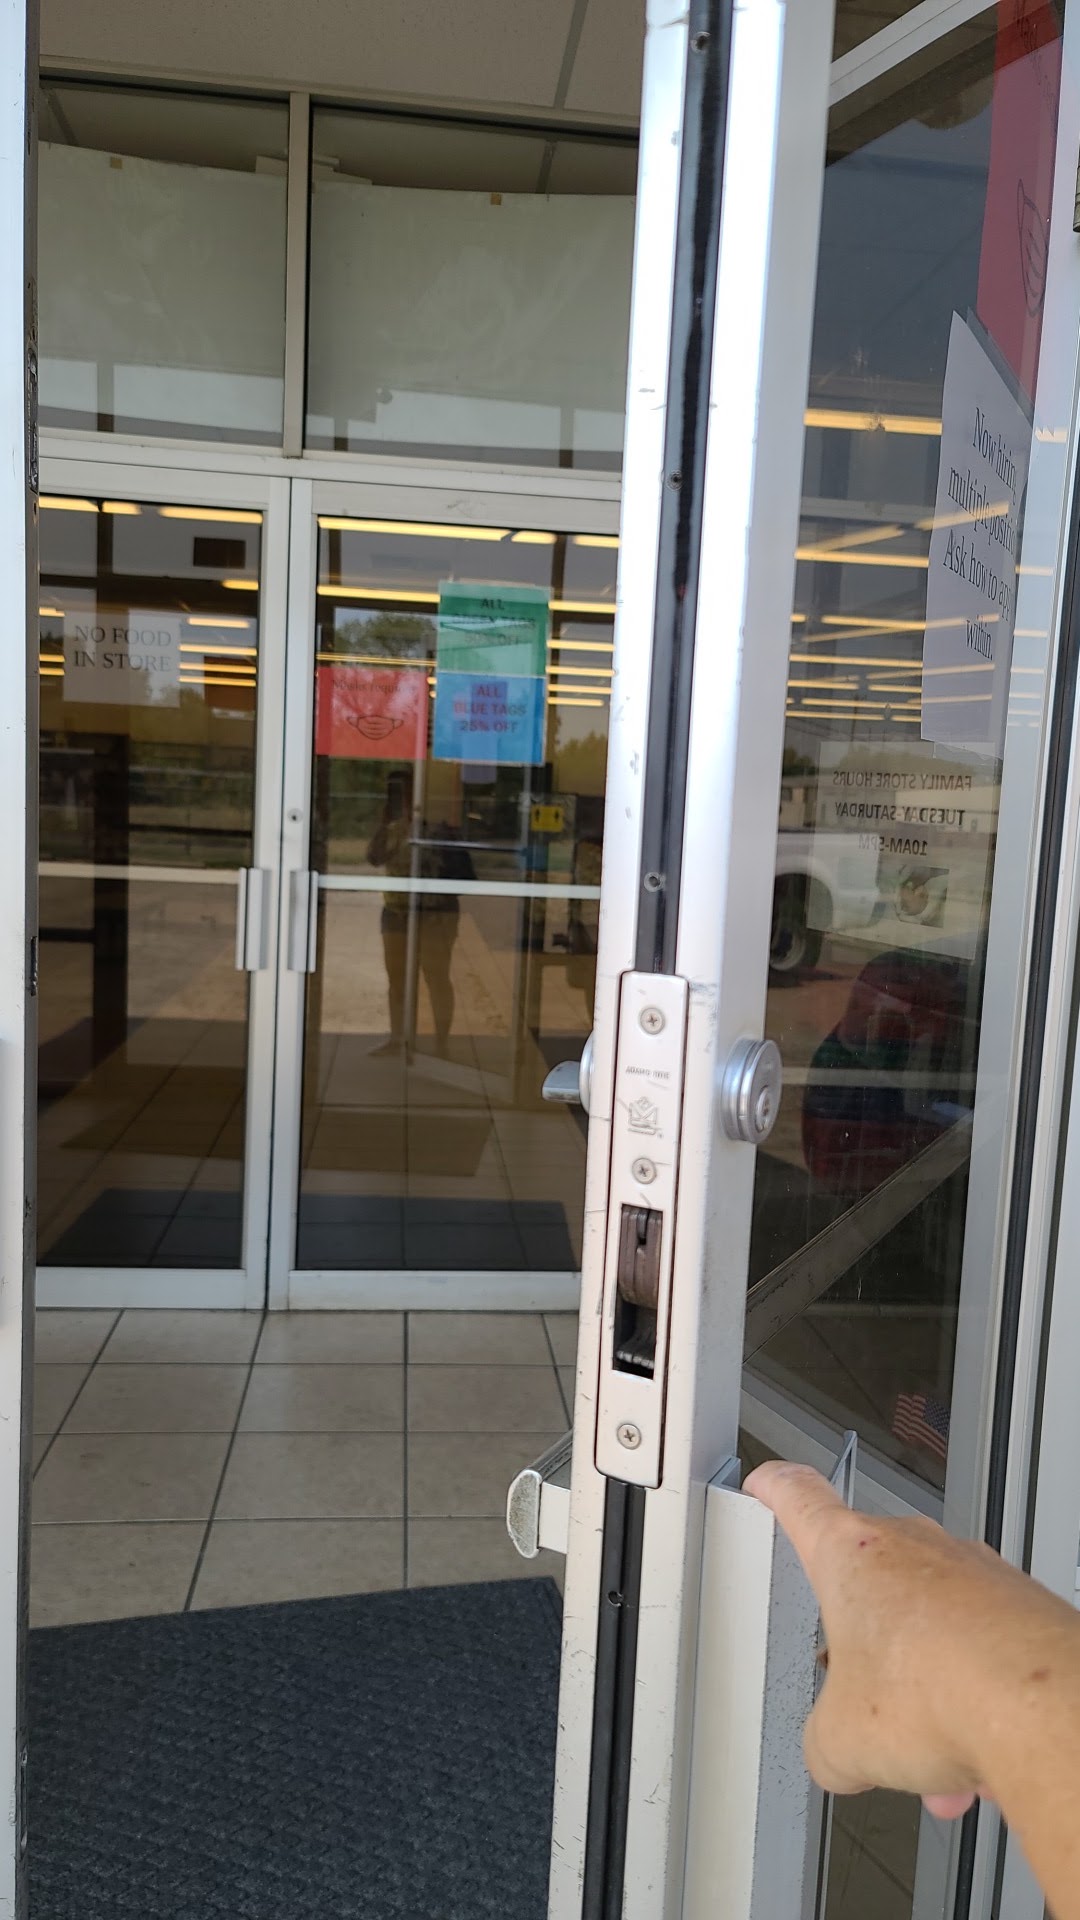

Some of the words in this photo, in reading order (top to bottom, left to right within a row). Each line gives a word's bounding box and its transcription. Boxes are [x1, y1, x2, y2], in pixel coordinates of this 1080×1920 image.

[973, 406, 997, 467] Now
[947, 467, 989, 531] multiple
[943, 529, 967, 578] Ask
[968, 542, 988, 594] how
[987, 567, 998, 601] to
[481, 598, 505, 610] ALL
[74, 625, 106, 643] NO
[112, 627, 172, 647] FOOD
[966, 613, 993, 661] within.
[74, 651, 96, 668] IN
[103, 653, 172, 673] STORE
[477, 684, 502, 697] ALL
[454, 700, 488, 715] BLUE
[490, 702, 526, 717] TAGS
[460, 720, 490, 733] 25%
[493, 721, 518, 733] OFF
